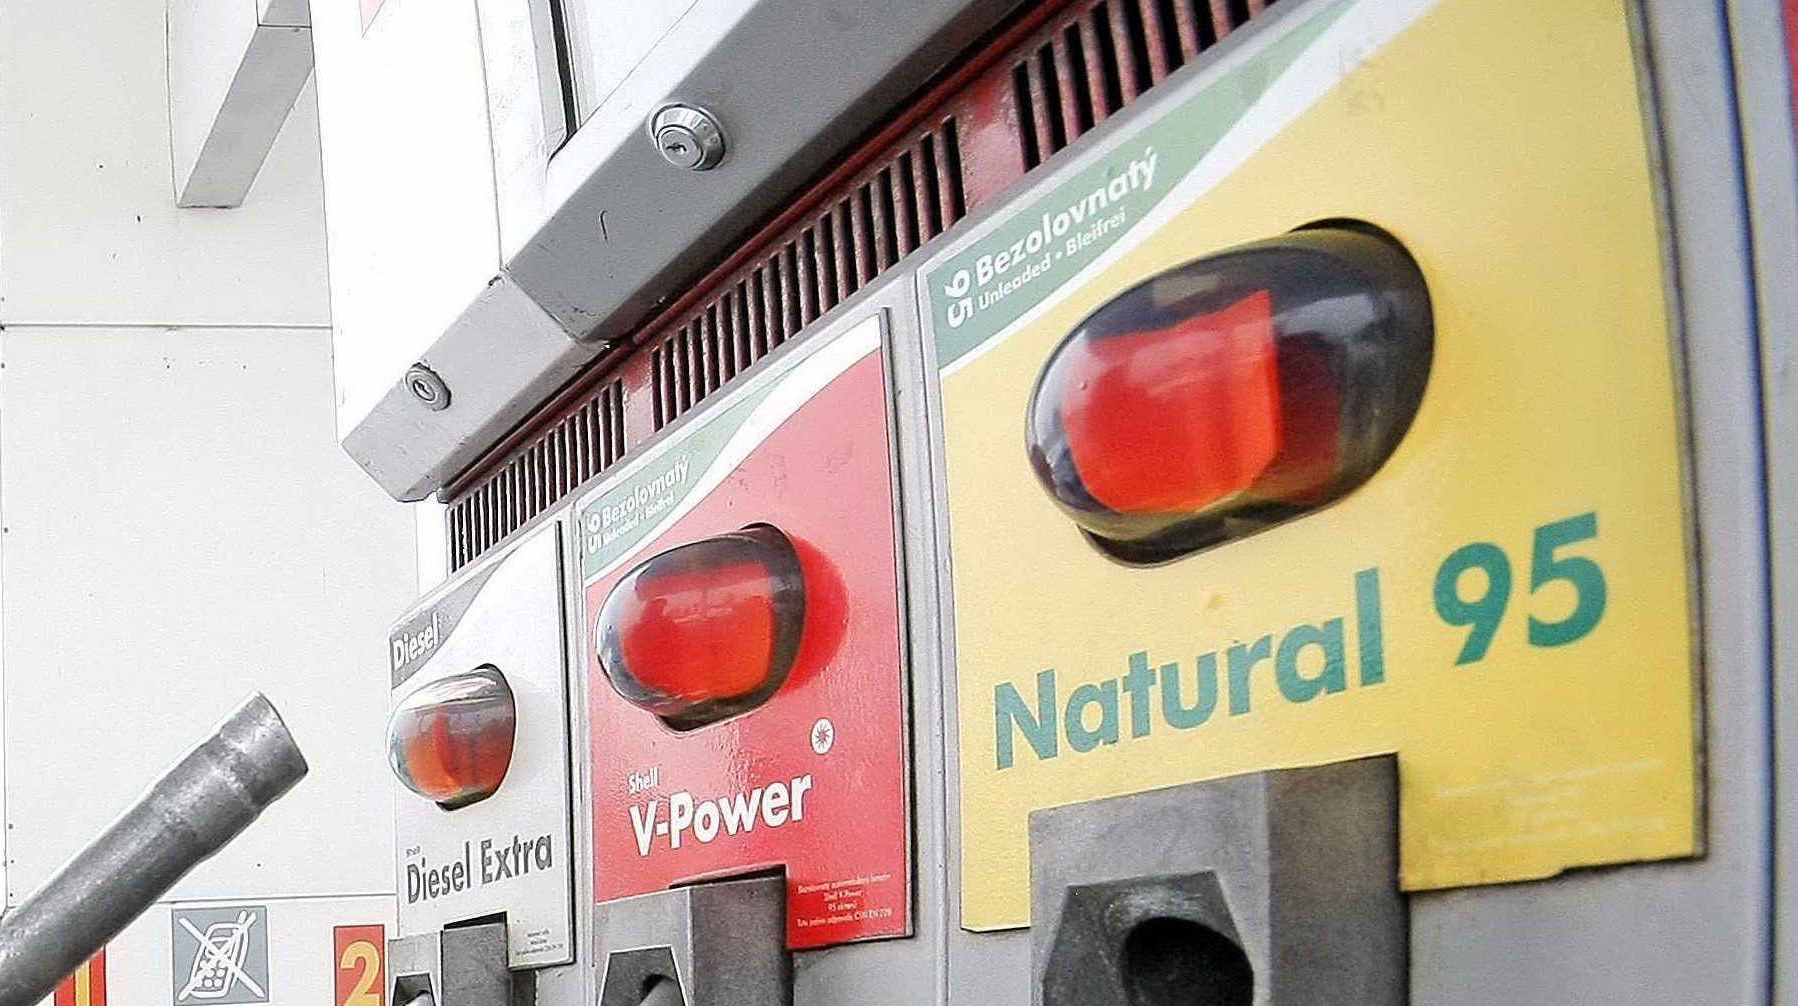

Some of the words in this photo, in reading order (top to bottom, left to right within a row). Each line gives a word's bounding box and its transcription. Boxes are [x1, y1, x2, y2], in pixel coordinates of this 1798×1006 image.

[976, 147, 1159, 287] Bezolovnatý
[978, 254, 1052, 311] Unleaded
[1065, 206, 1126, 257] Bleifrei
[393, 611, 440, 671] Diesel
[994, 569, 1385, 771] Natural
[1432, 511, 1608, 668] 95
[627, 766, 659, 794] Shell
[629, 774, 814, 857] V-Power
[406, 840, 472, 905] Diesel
[480, 833, 553, 886] Extra
